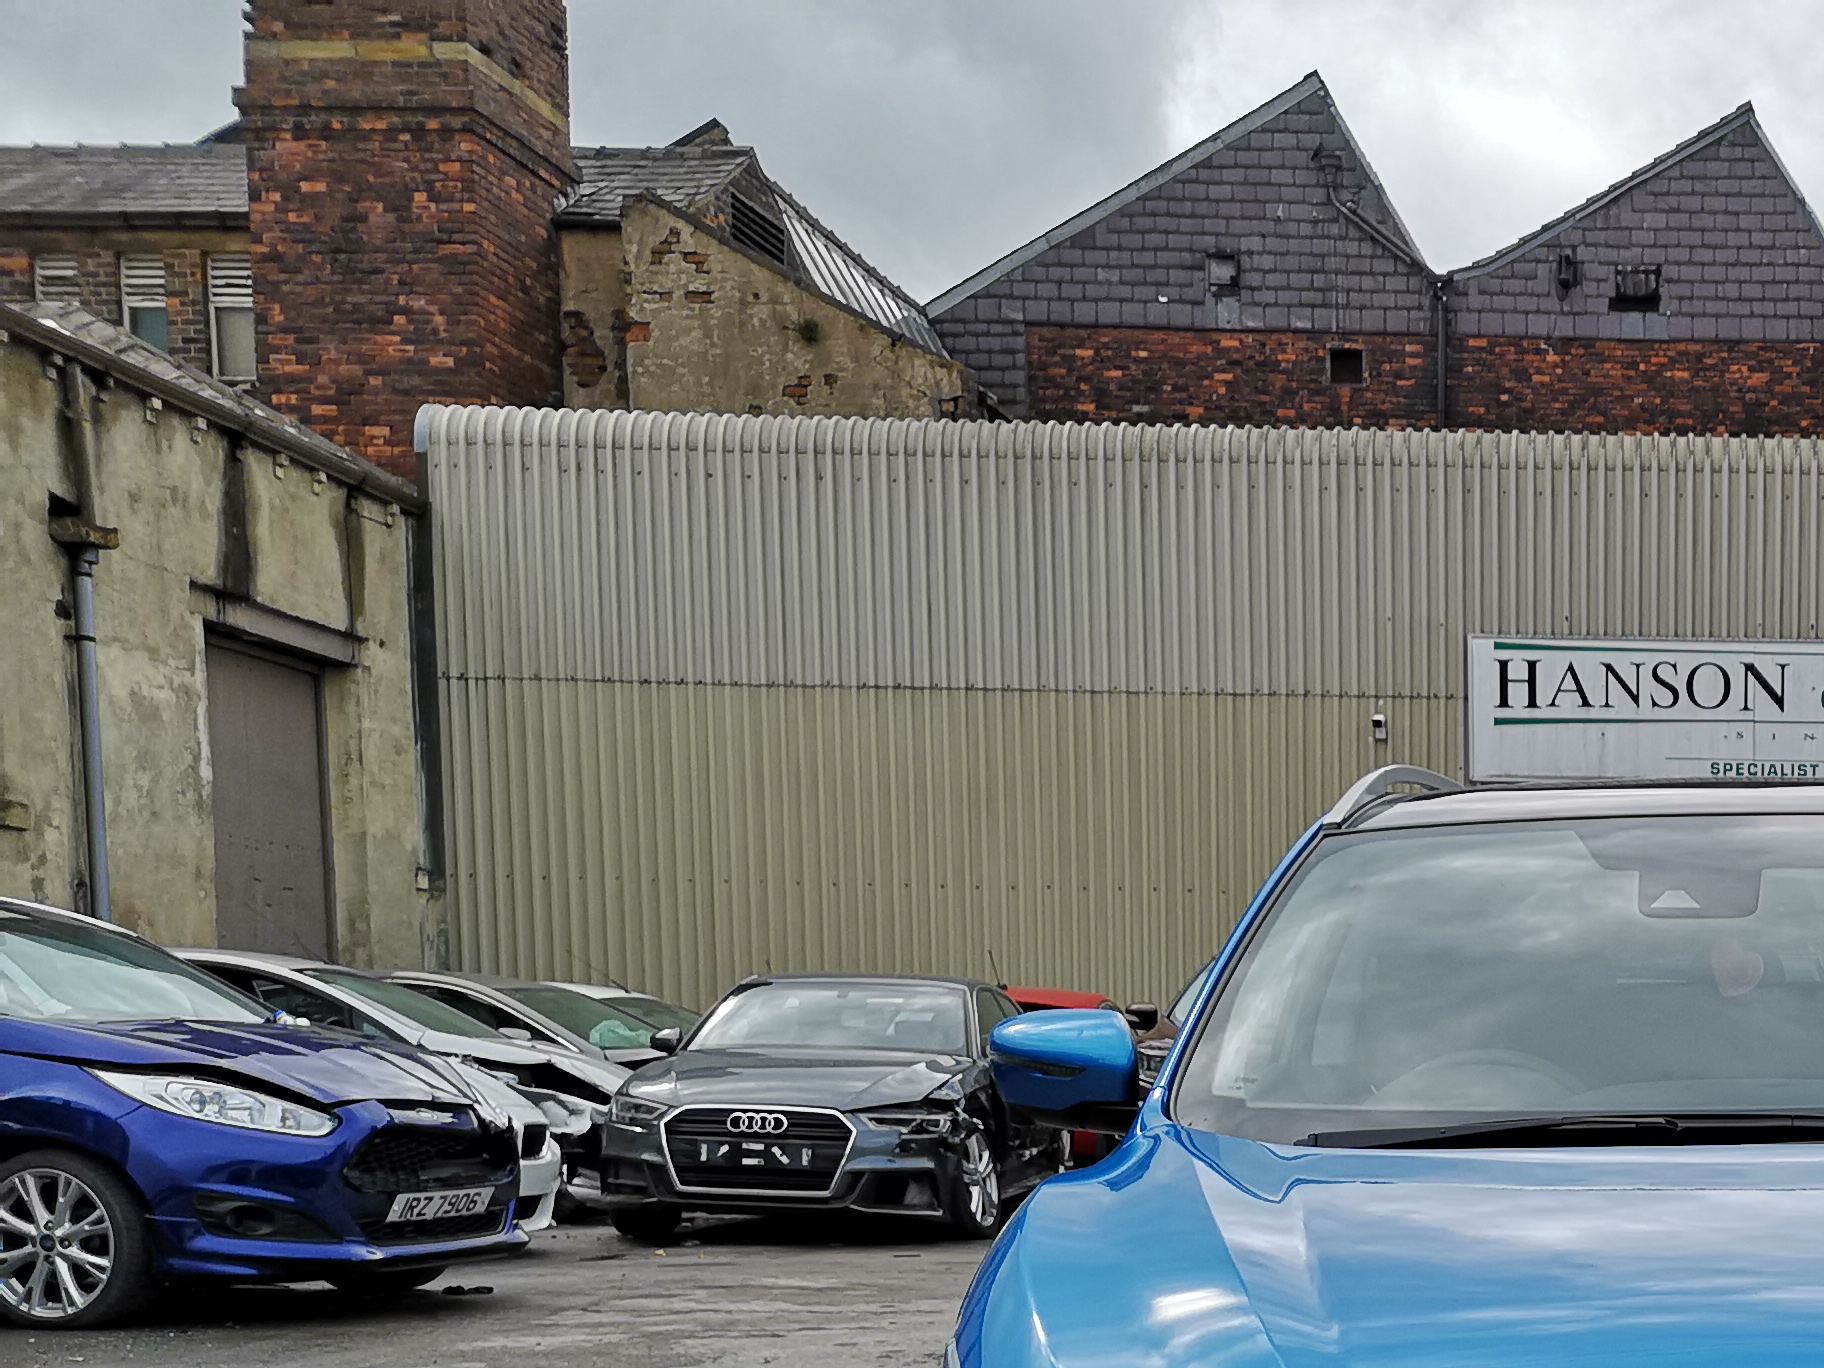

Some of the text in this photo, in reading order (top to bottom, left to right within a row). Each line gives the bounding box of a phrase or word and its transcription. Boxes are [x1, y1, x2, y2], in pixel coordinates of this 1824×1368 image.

[1493, 658, 1791, 713] HANSON
[1710, 761, 1820, 777] SPECIALIST
[398, 1191, 483, 1219] IRZ 7906
